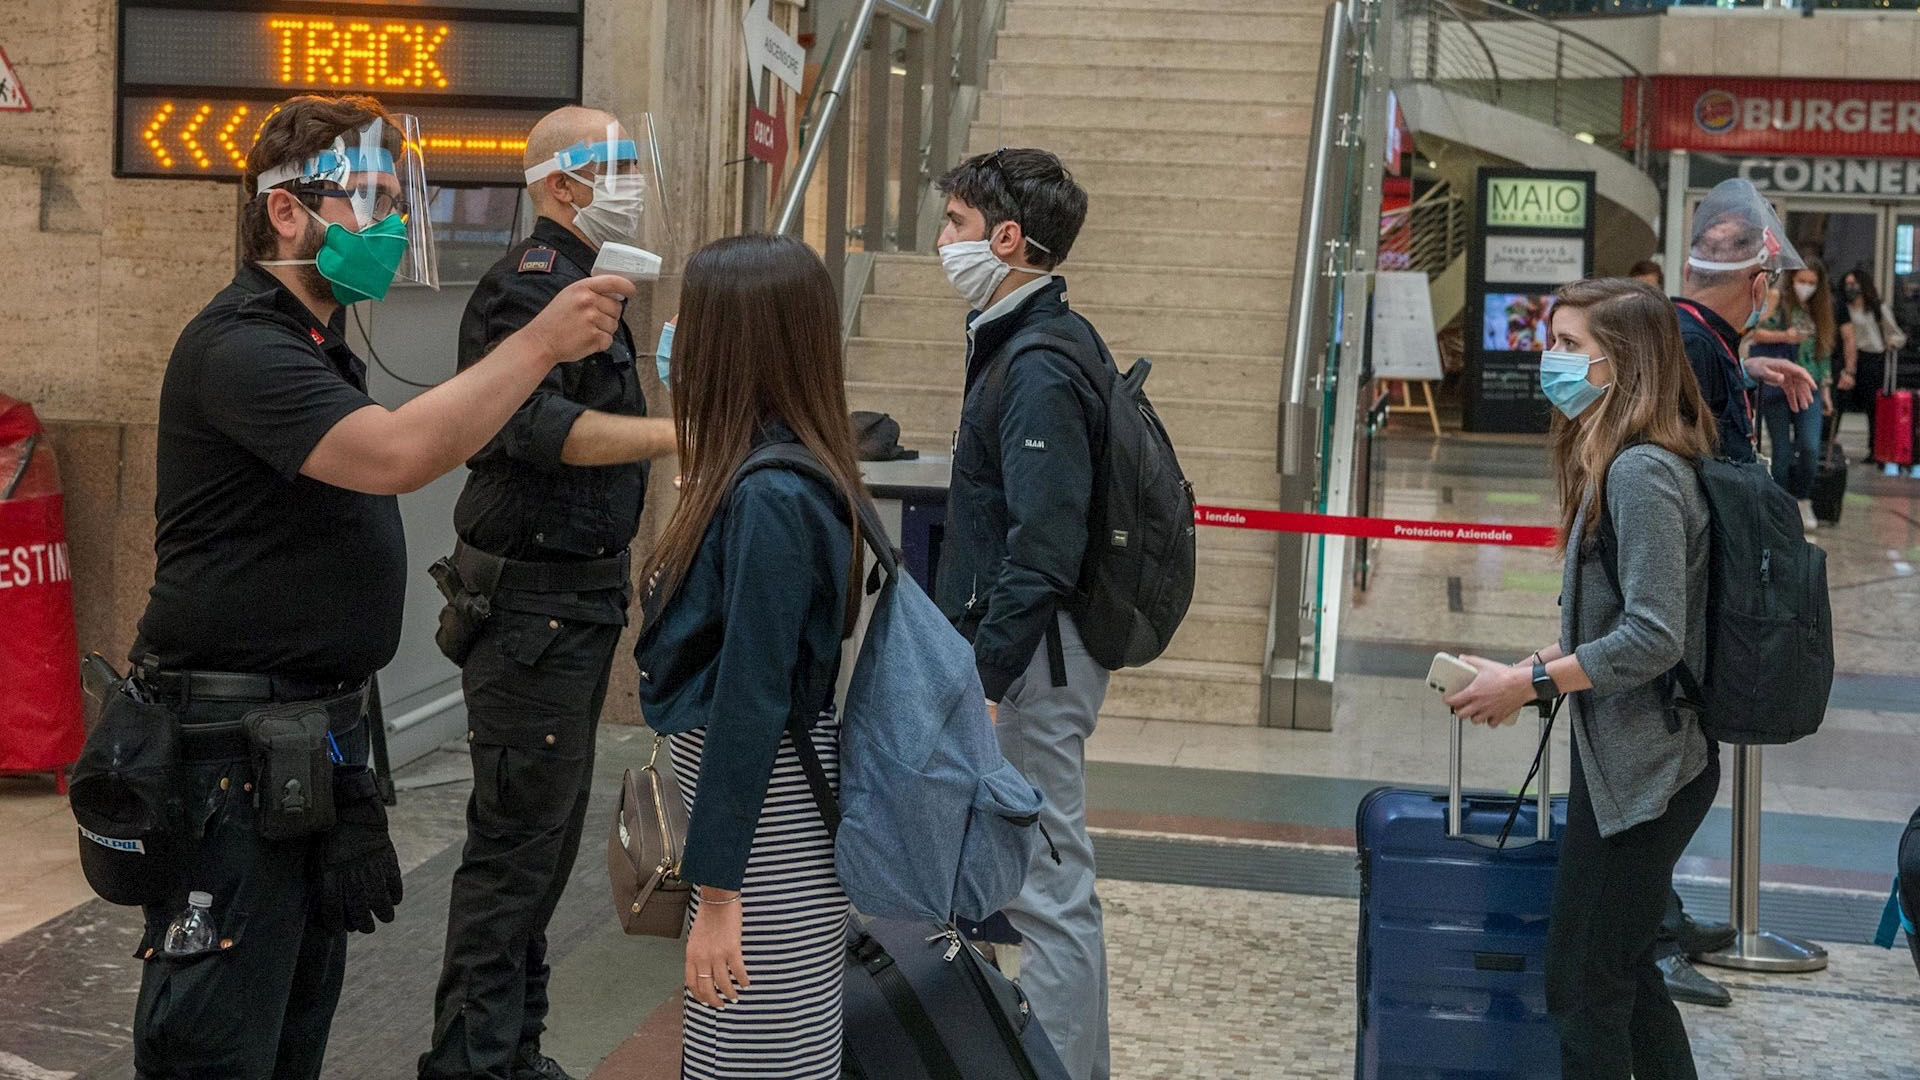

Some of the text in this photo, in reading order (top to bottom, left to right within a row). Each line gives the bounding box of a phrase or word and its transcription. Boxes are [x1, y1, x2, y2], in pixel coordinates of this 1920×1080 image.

[271, 20, 449, 88] TRACK
[764, 36, 799, 76] ASCENSORE
[1743, 98, 1920, 134] BURGER
[1491, 184, 1581, 214] MAIO
[1394, 525, 1513, 541] Protezione Aziendale
